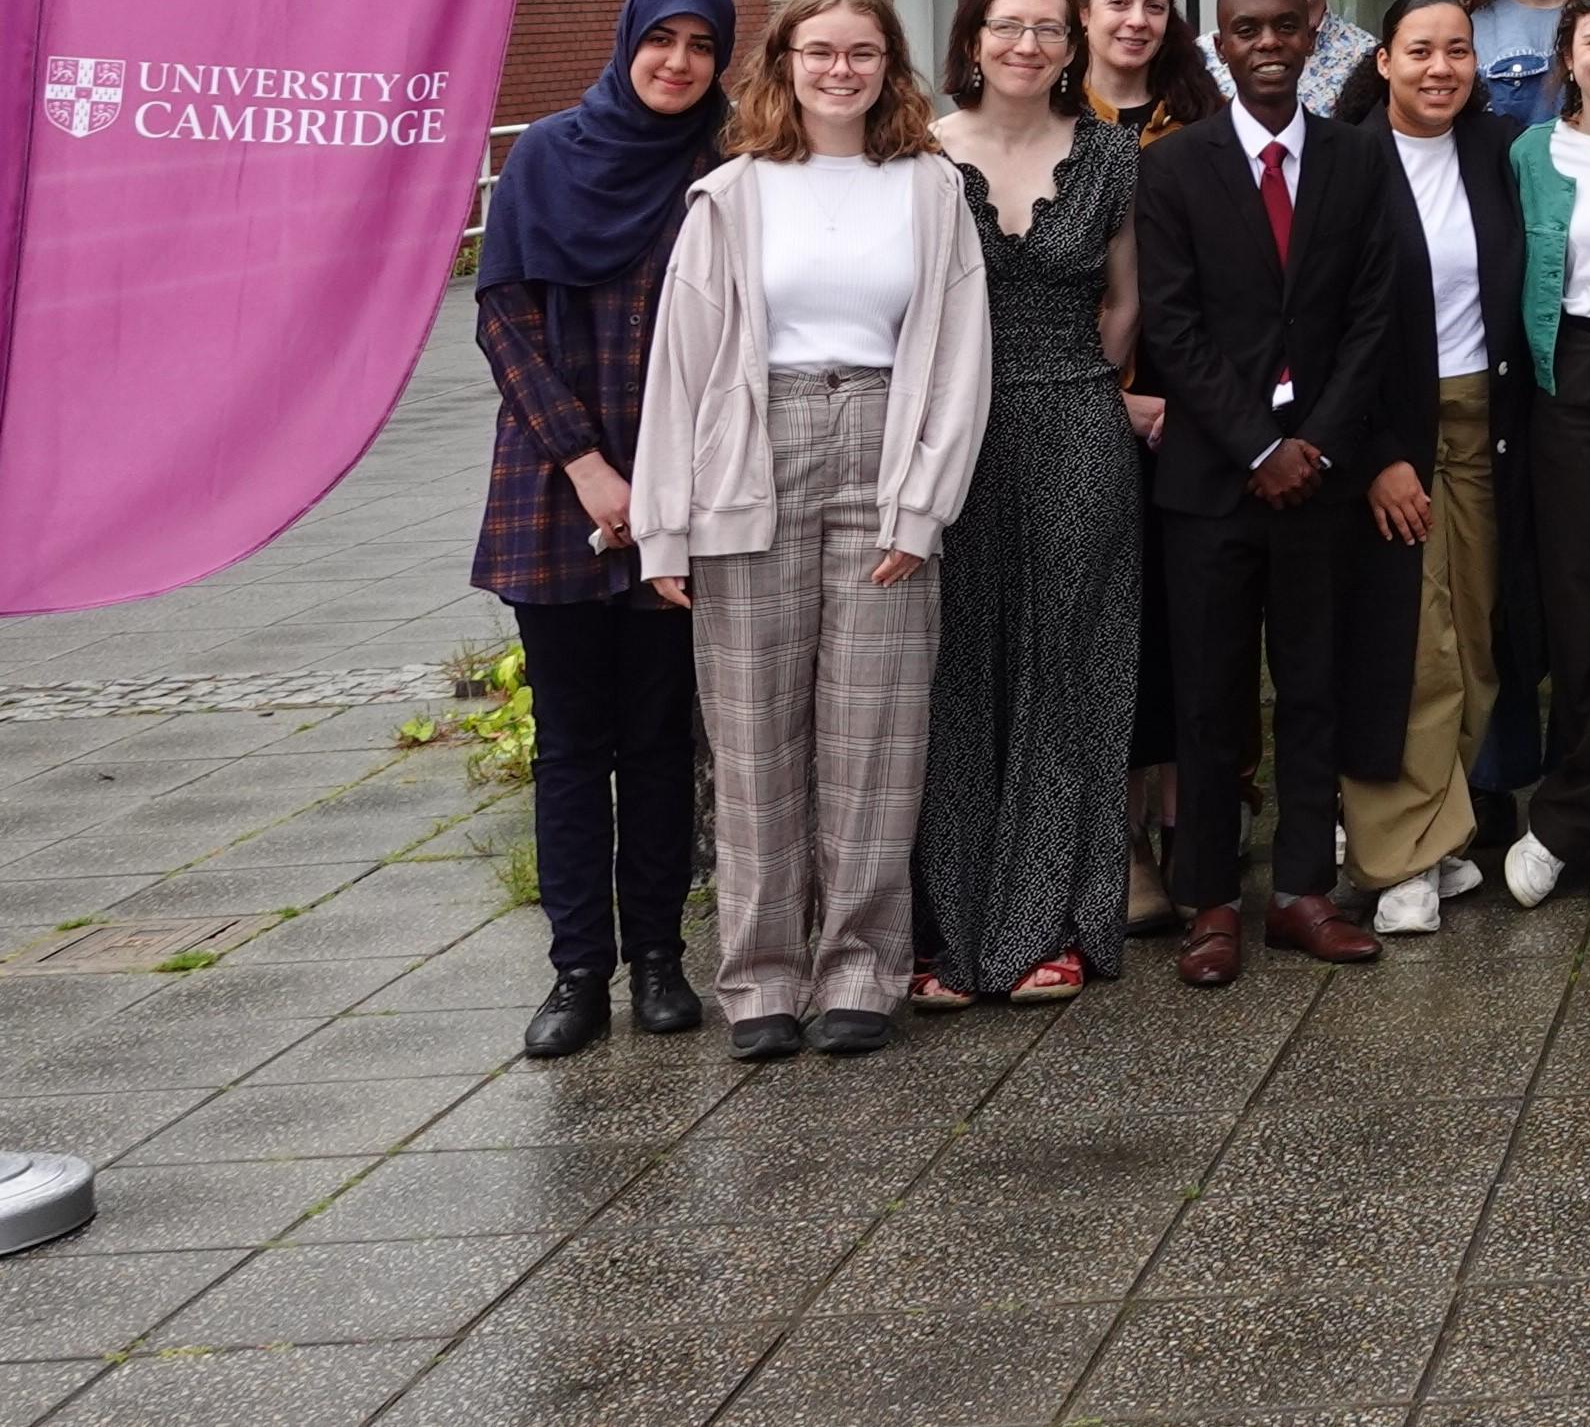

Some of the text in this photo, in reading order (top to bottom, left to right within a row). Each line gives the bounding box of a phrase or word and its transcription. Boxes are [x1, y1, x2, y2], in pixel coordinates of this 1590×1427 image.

[139, 61, 450, 103] UNIVERSITY OF
[134, 100, 447, 147] CAMBRIDGE
